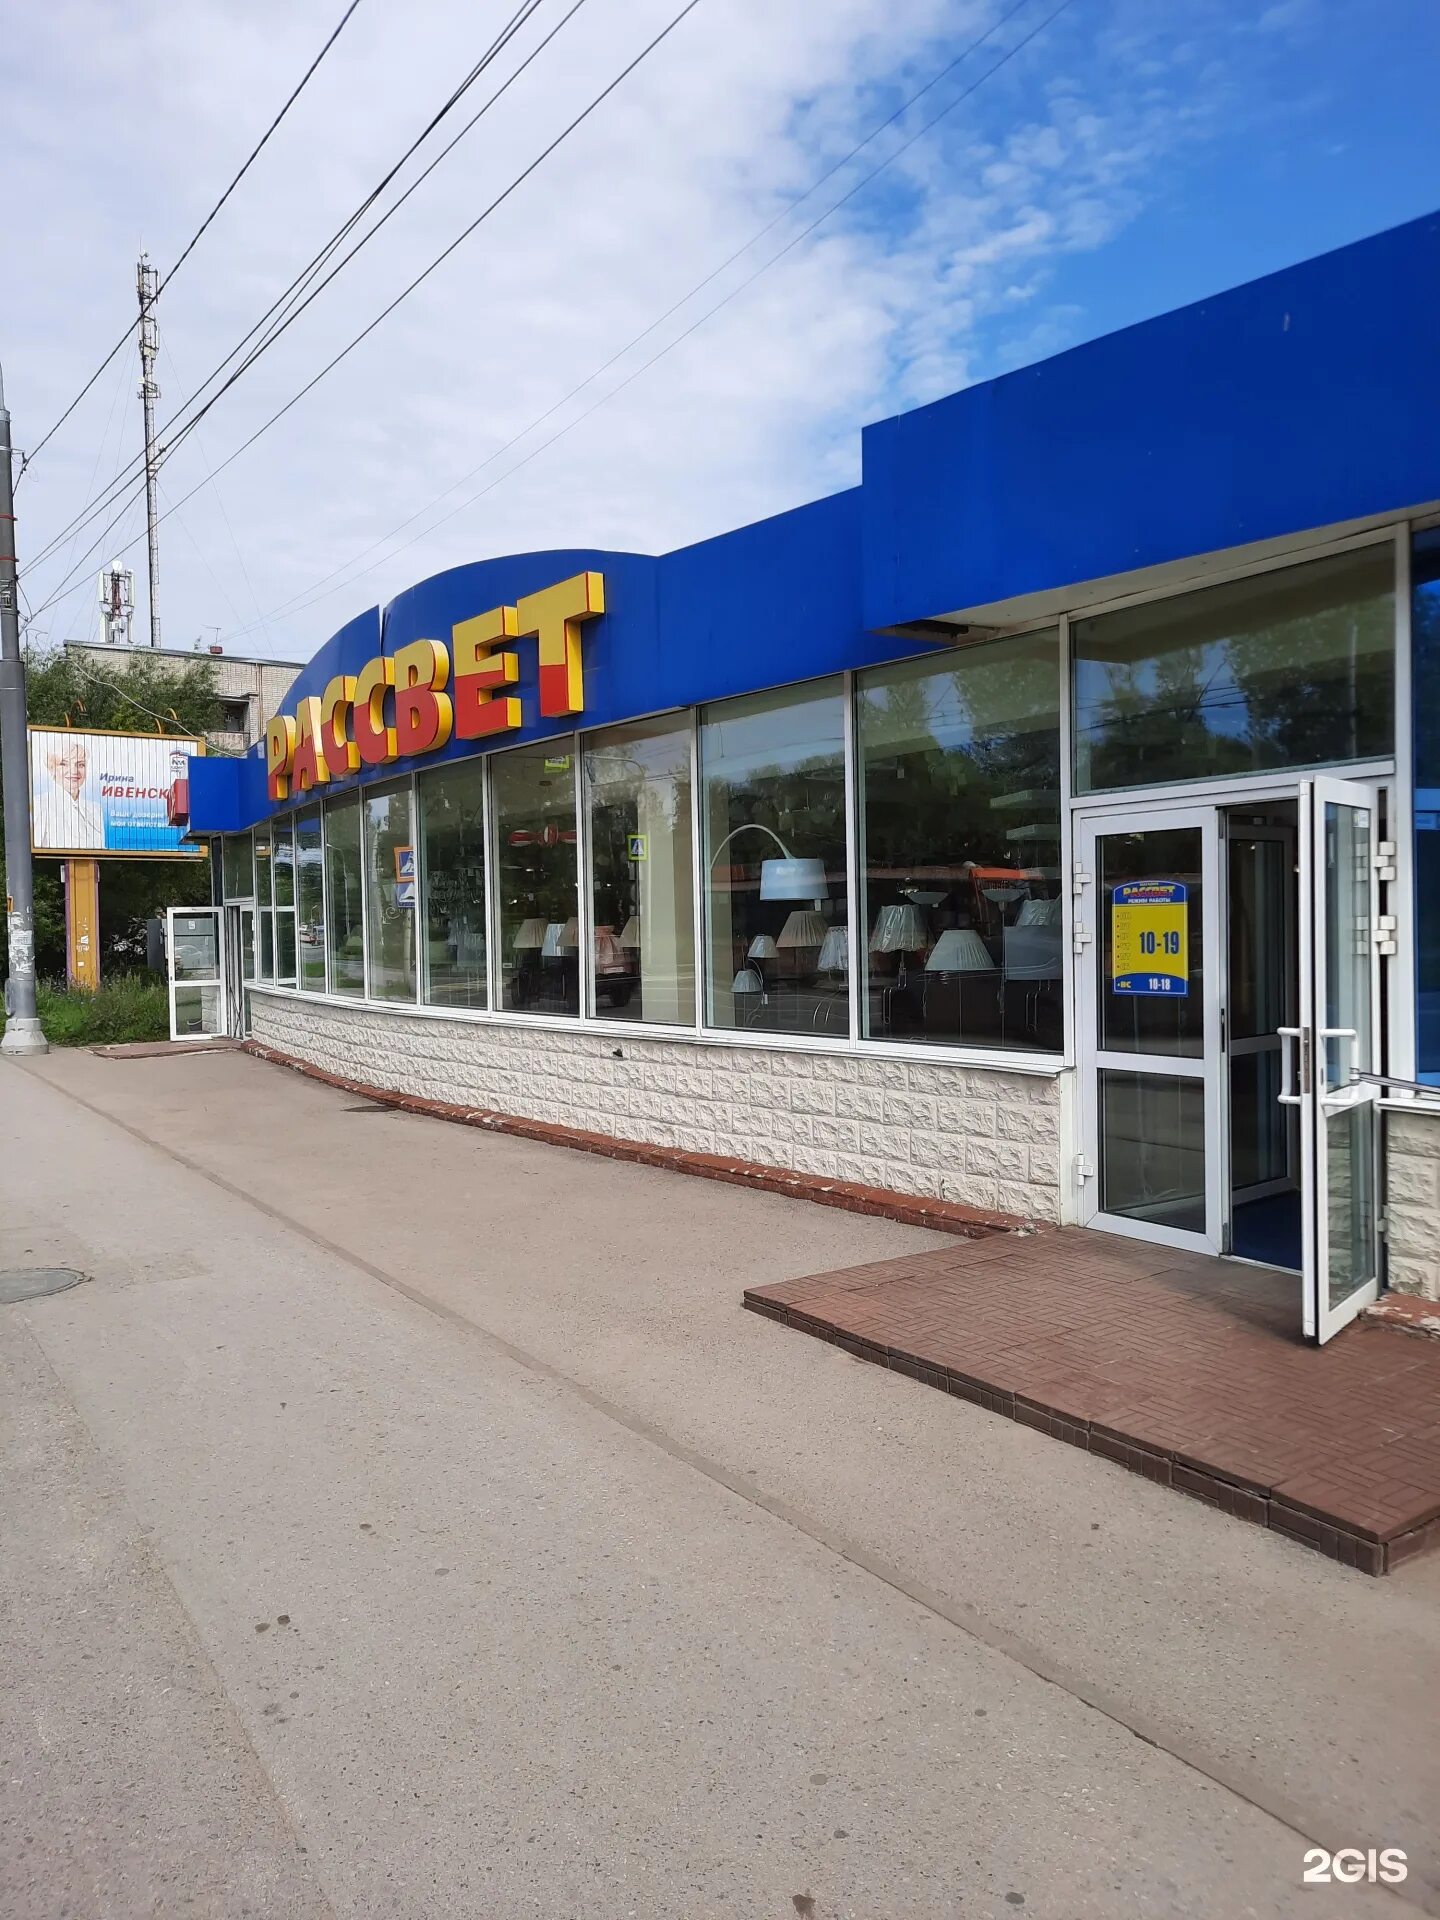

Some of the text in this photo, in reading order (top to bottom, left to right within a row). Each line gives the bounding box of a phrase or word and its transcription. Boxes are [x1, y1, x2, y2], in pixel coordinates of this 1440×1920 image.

[266, 571, 605, 801] РАССВЕТ
[100, 773, 134, 783] Ирина
[1123, 885, 1175, 897] РАССВЕТ
[1139, 931, 1179, 954] 10-19
[1148, 978, 1171, 991] 10-18
